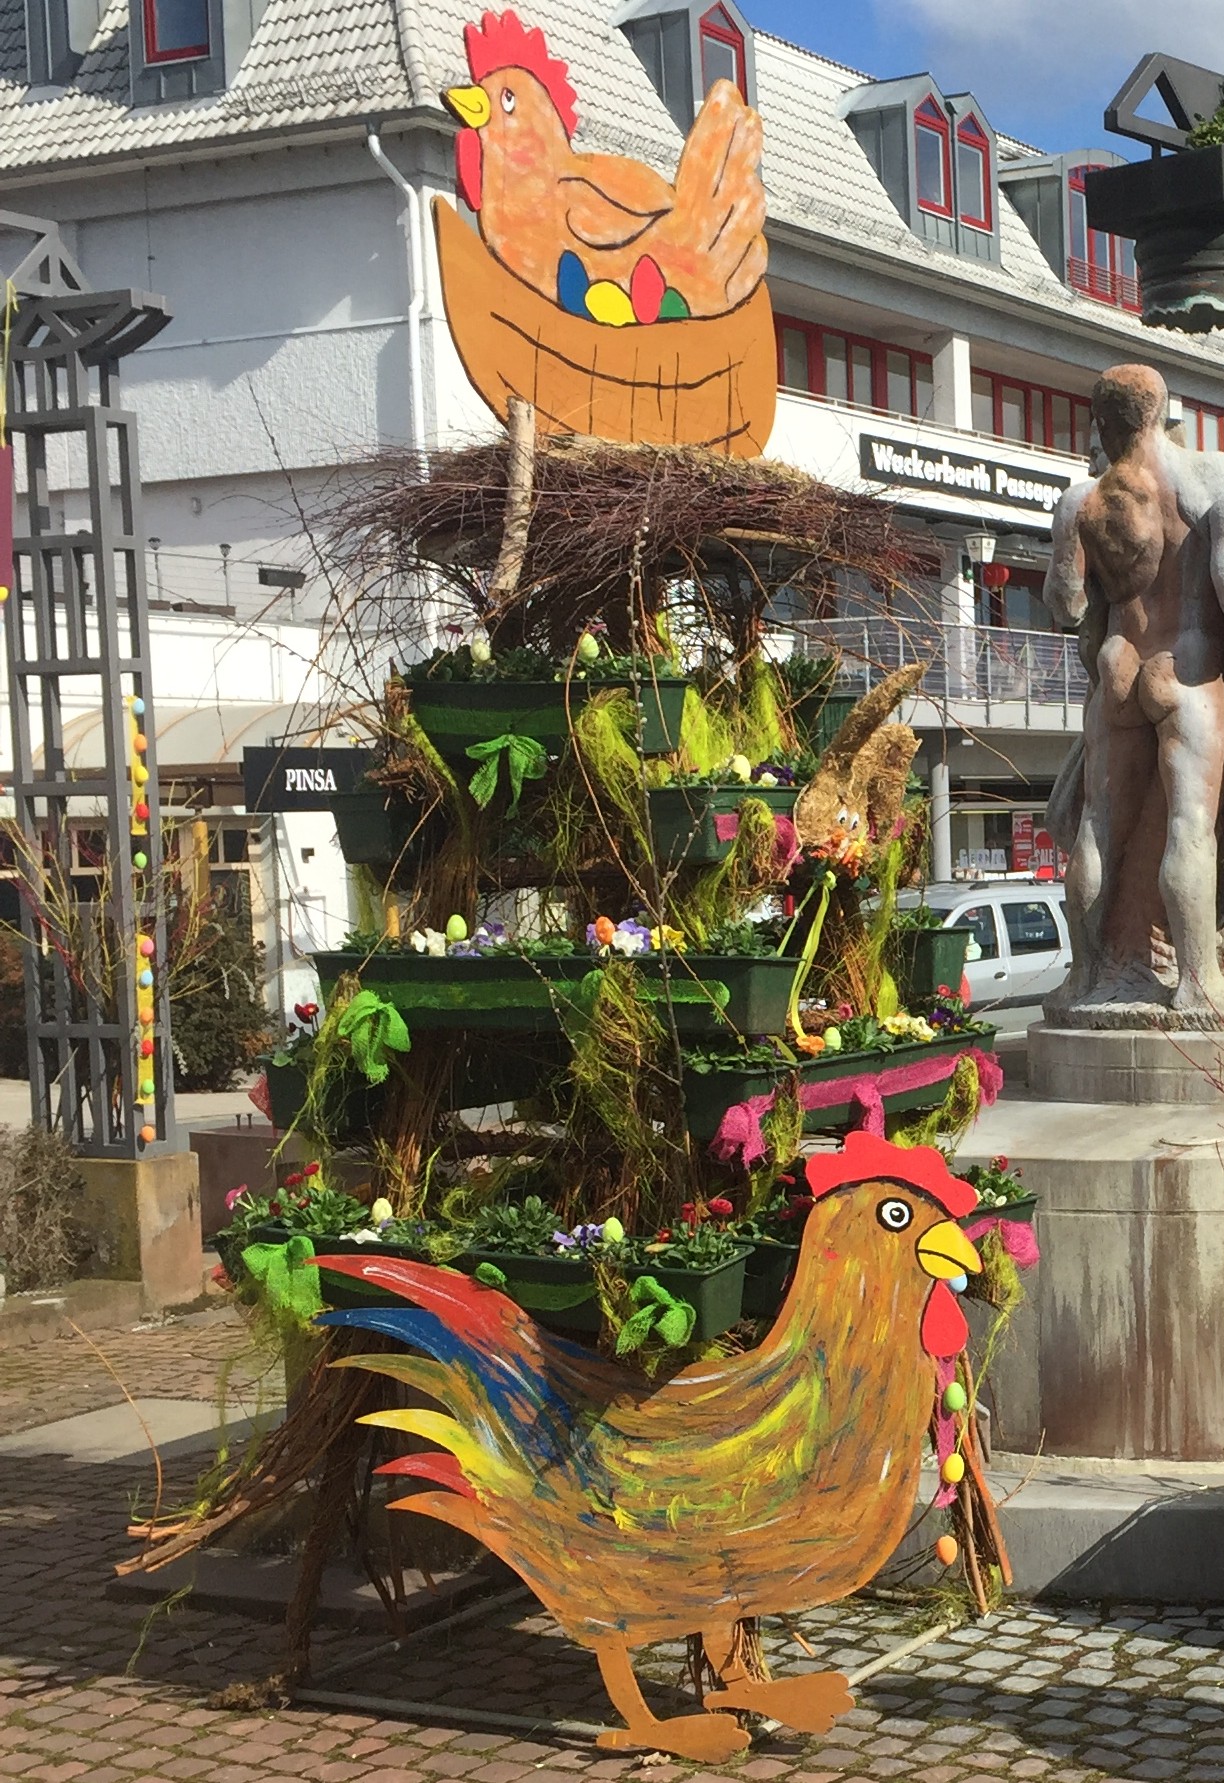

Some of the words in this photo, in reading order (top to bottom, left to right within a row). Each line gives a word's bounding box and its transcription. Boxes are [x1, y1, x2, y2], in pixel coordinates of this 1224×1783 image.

[871, 441, 991, 493] Wackerbarth
[996, 467, 1063, 511] Passage
[285, 768, 338, 792] PINSA
